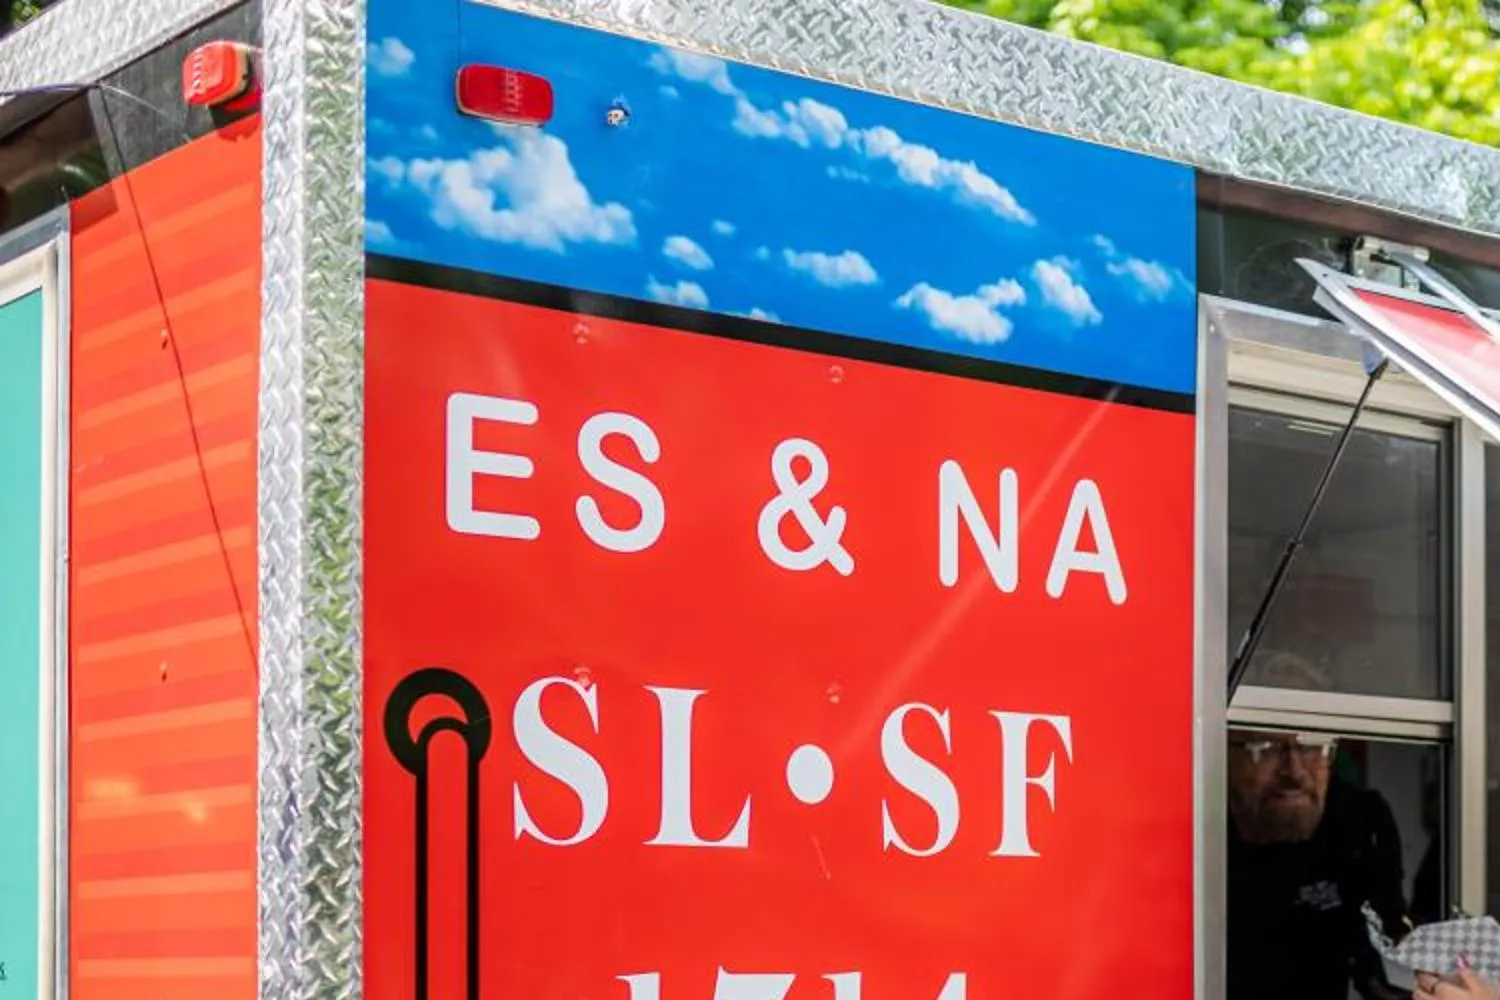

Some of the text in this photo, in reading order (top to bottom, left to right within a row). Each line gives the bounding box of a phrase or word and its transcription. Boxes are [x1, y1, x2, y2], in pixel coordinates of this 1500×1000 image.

[445, 392, 1127, 605] ES & NA
